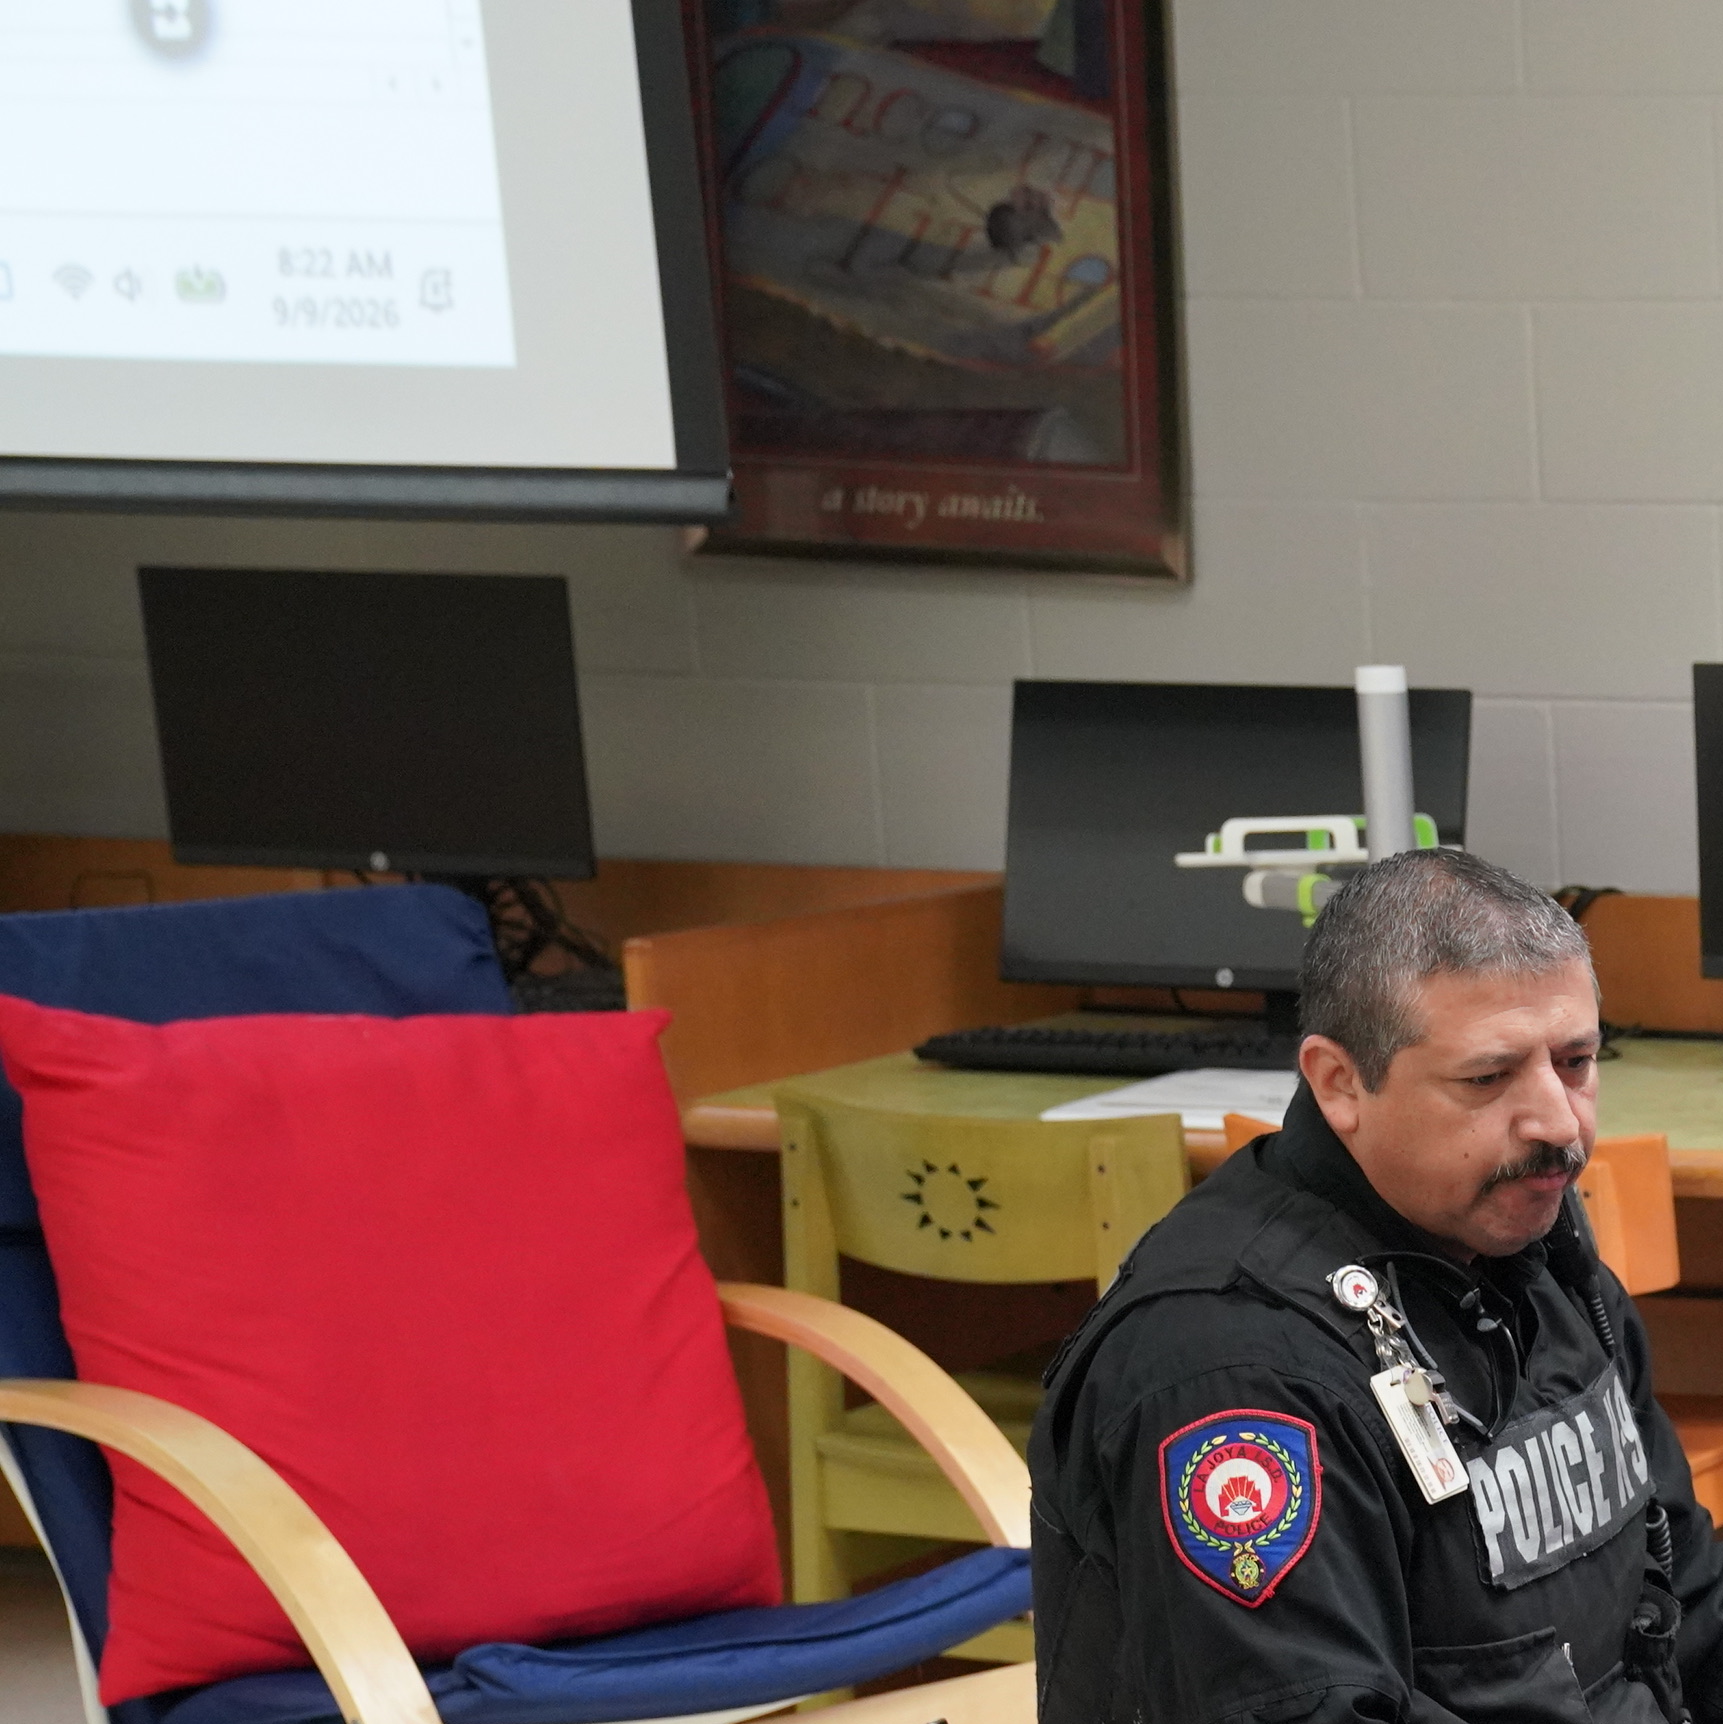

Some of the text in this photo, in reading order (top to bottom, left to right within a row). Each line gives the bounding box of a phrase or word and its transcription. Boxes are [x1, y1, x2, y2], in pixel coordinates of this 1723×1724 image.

[277, 246, 394, 279] 8:22 AM
[271, 295, 401, 329] 9/9/2026
[1425, 1403, 1450, 1445] POLICE
[1194, 1472, 1207, 1493] LA
[1209, 1445, 1247, 1470] JOYA
[1466, 1374, 1648, 1579] POLICE K-9
[1213, 1513, 1273, 1536] POLICE
